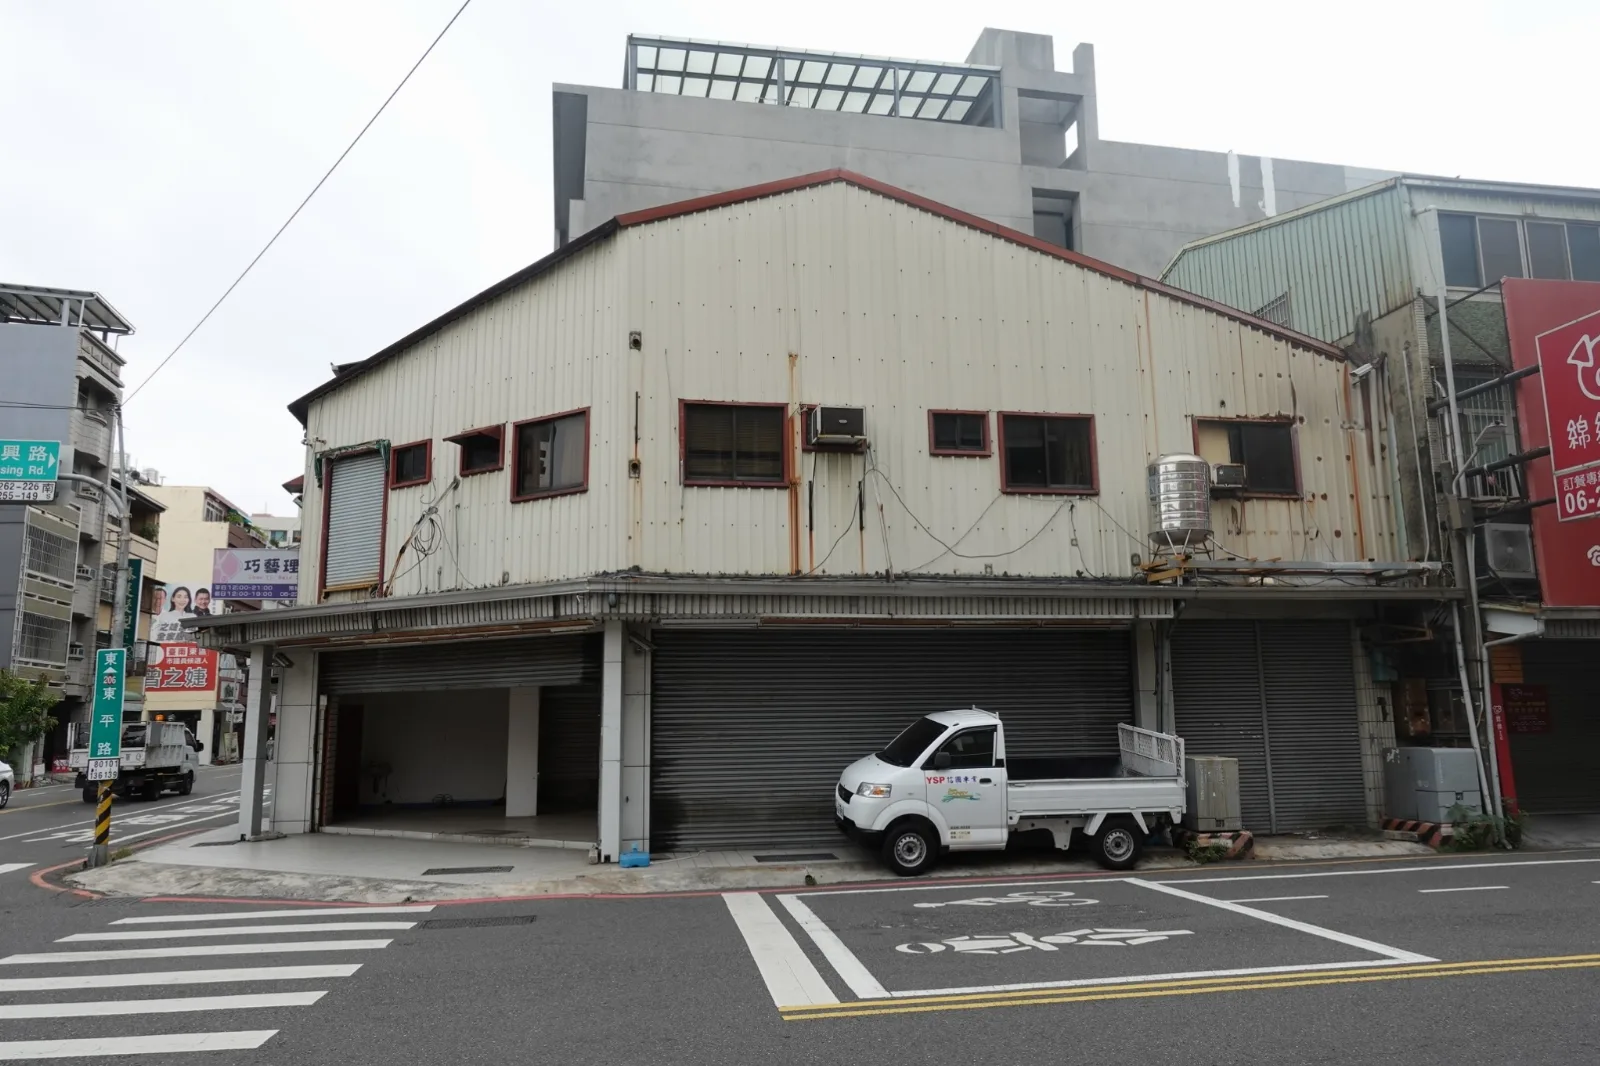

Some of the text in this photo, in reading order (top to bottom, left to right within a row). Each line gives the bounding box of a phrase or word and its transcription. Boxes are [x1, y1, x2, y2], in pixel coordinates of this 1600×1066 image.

[1, 445, 48, 461] 興路
[29, 465, 46, 475] Rd.
[42, 483, 54, 493] 南
[1563, 472, 1600, 491] 訂餐專
[244, 558, 299, 573] 巧藝理
[104, 652, 117, 665] 東
[96, 686, 117, 756] 東平路
[926, 776, 945, 784] YSP
